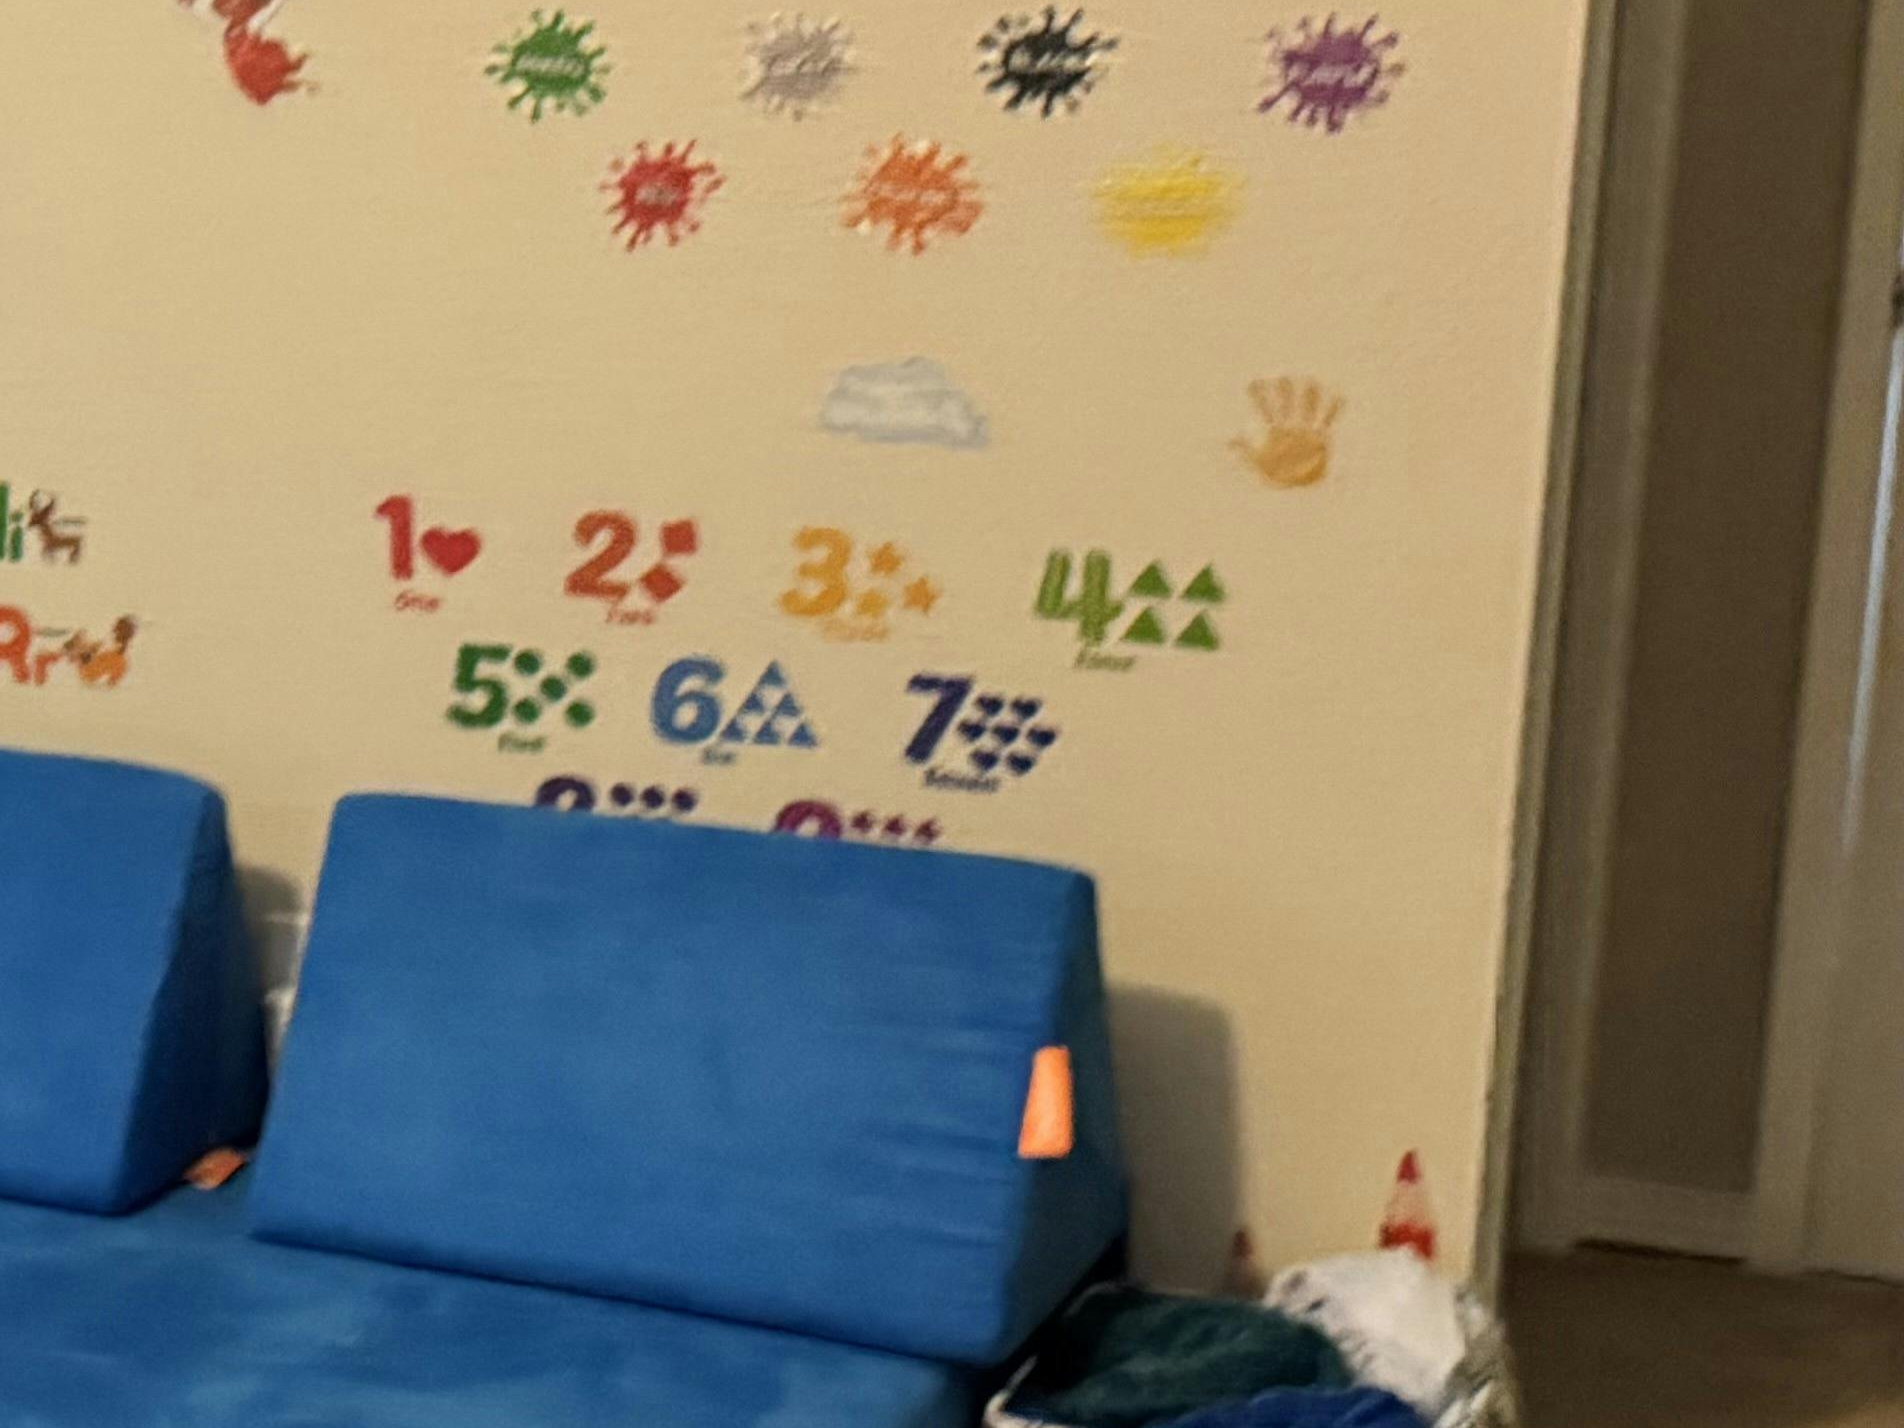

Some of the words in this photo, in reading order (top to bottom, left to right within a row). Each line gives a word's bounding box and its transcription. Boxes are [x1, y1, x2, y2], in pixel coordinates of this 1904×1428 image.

[373, 494, 415, 581] 1
[563, 509, 638, 602] 2
[779, 527, 853, 618] 3
[1033, 549, 1124, 648] 4
[445, 643, 513, 730] 5
[649, 655, 726, 745] 6
[902, 672, 976, 764] 7
